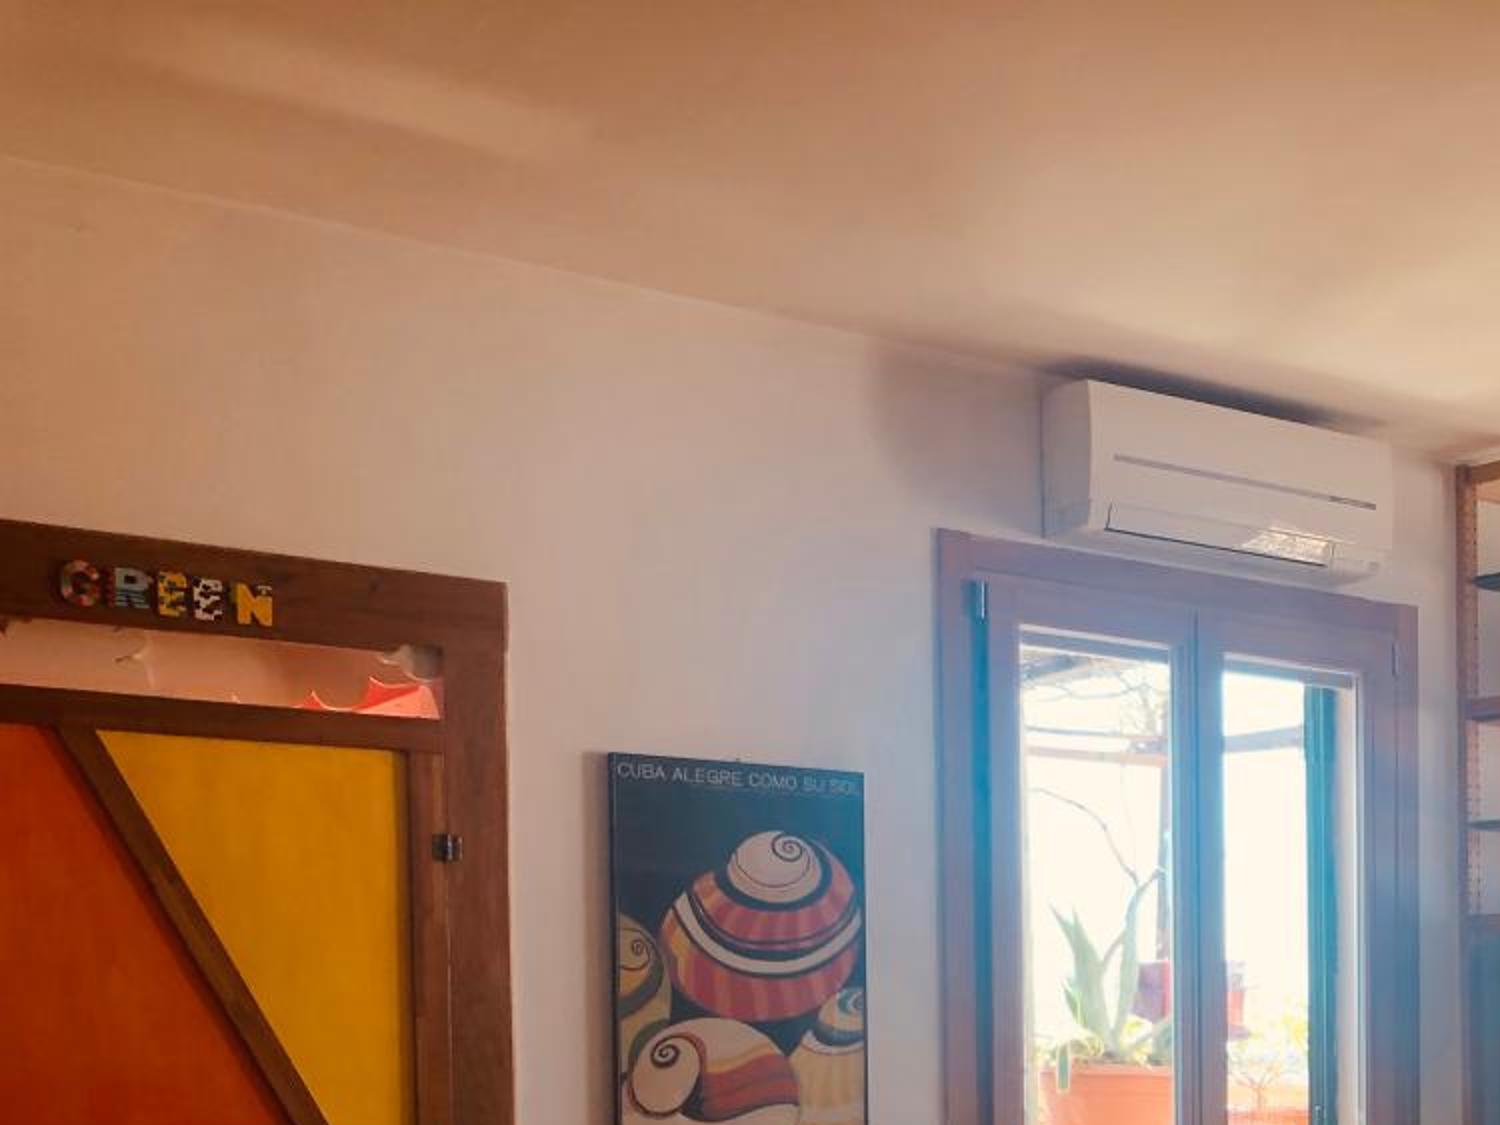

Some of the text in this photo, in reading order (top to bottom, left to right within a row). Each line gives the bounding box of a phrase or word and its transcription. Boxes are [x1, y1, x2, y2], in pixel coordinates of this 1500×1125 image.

[60, 559, 273, 627] GREEN
[617, 762, 665, 779] CUBA
[672, 767, 743, 786] ALEGRE
[749, 772, 797, 790] COMO
